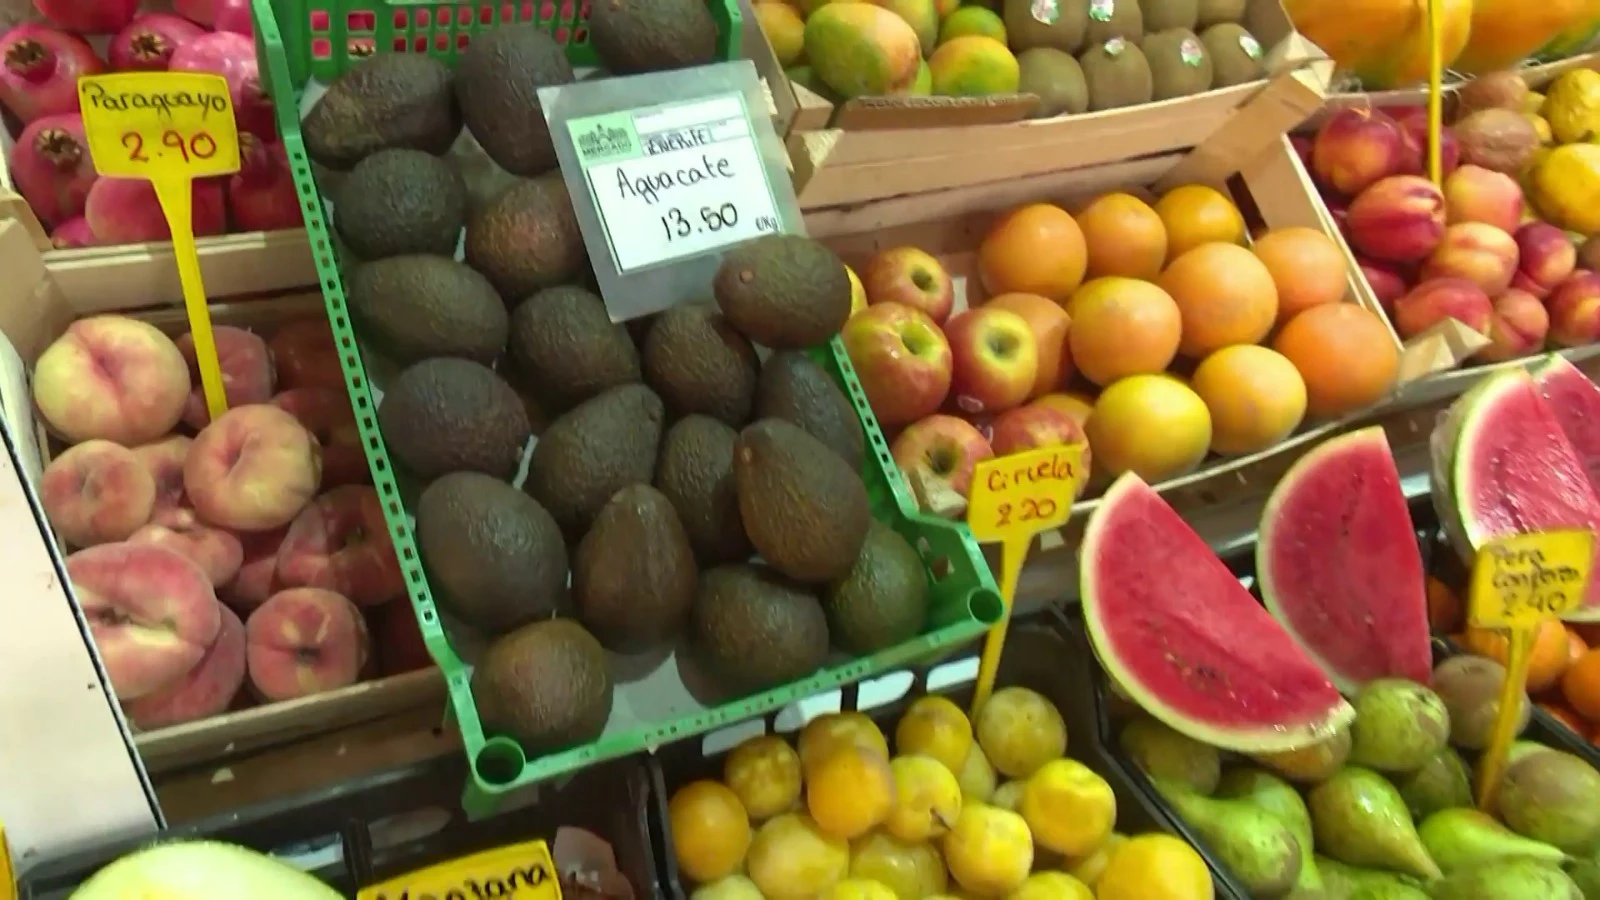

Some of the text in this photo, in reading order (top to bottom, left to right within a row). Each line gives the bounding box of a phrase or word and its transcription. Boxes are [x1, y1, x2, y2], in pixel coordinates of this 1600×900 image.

[82, 81, 227, 121] Paraguayo
[121, 130, 217, 163] 2.90
[616, 155, 737, 205] Aguacate
[661, 202, 739, 241] 13.50
[988, 454, 1074, 492] Ciruela
